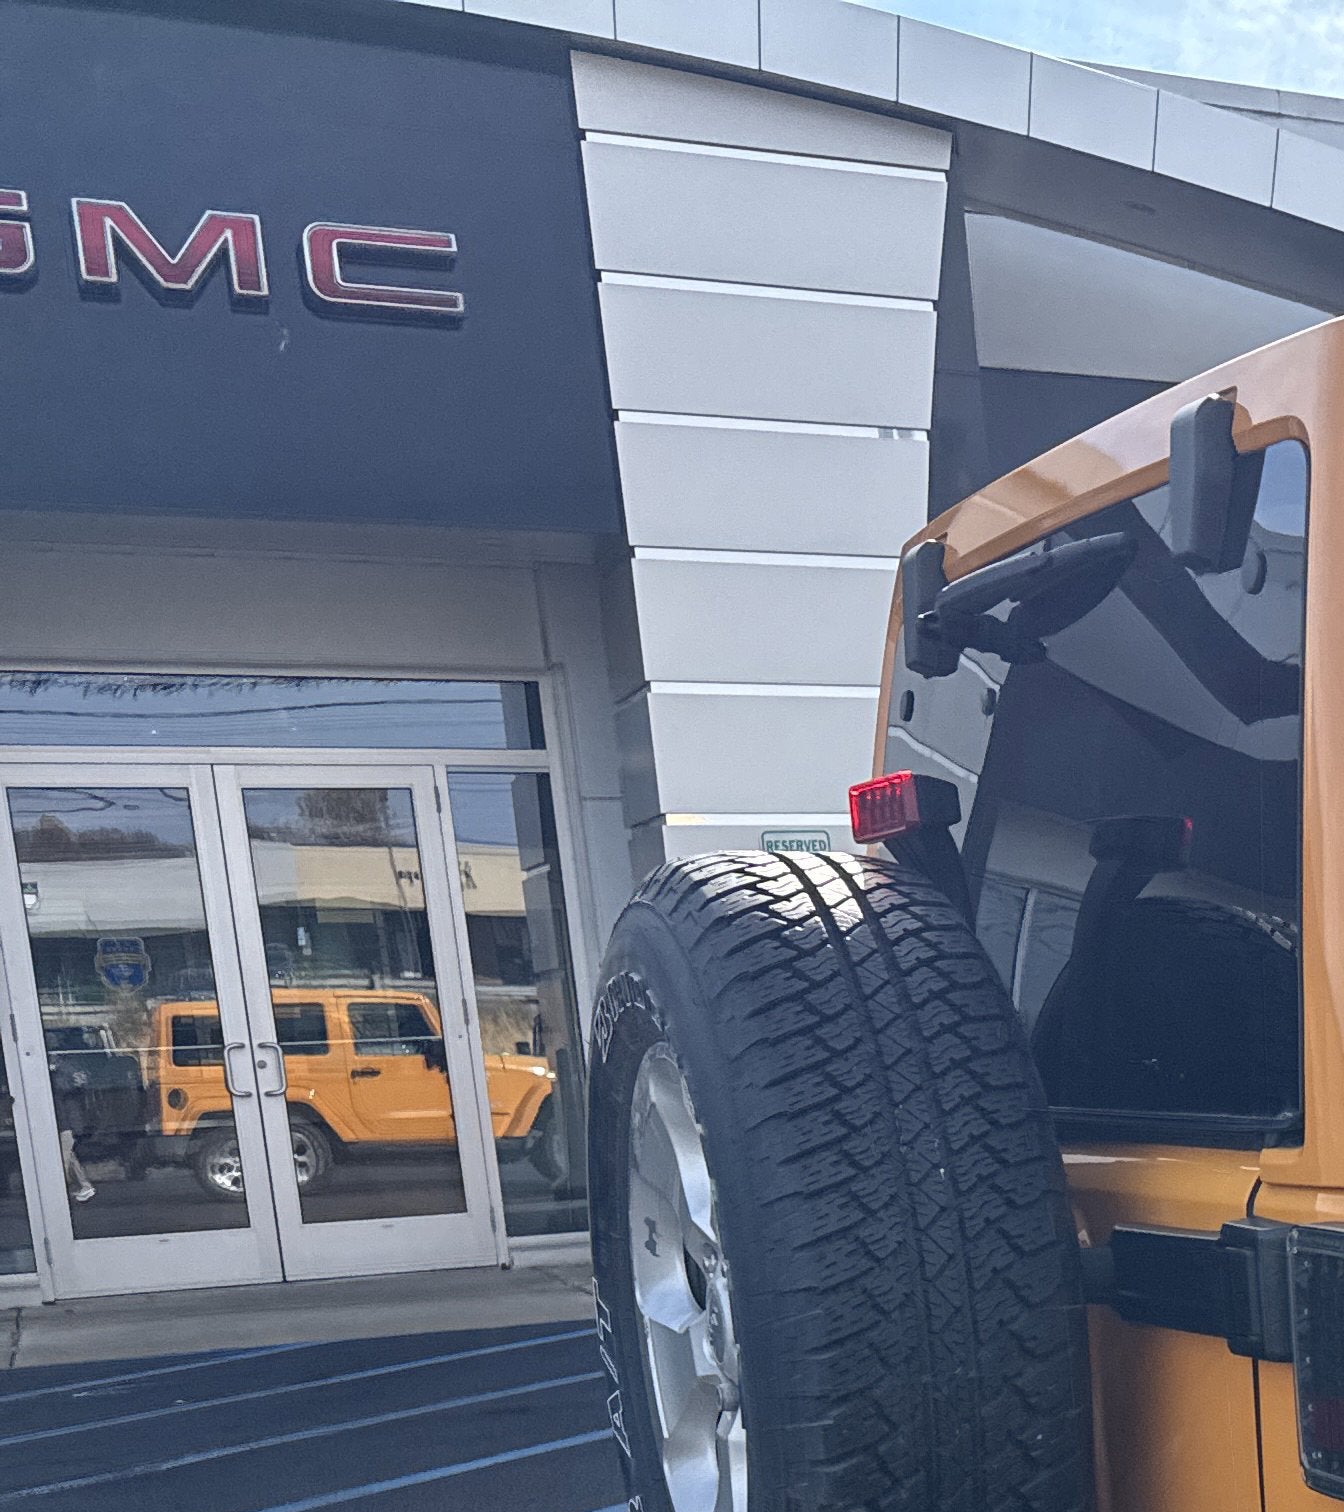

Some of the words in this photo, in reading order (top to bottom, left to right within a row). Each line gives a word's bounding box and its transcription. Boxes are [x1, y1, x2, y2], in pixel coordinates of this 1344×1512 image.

[0, 188, 464, 313] MC
[766, 839, 827, 852] RESERVED
[592, 1276, 632, 1459] A/T
